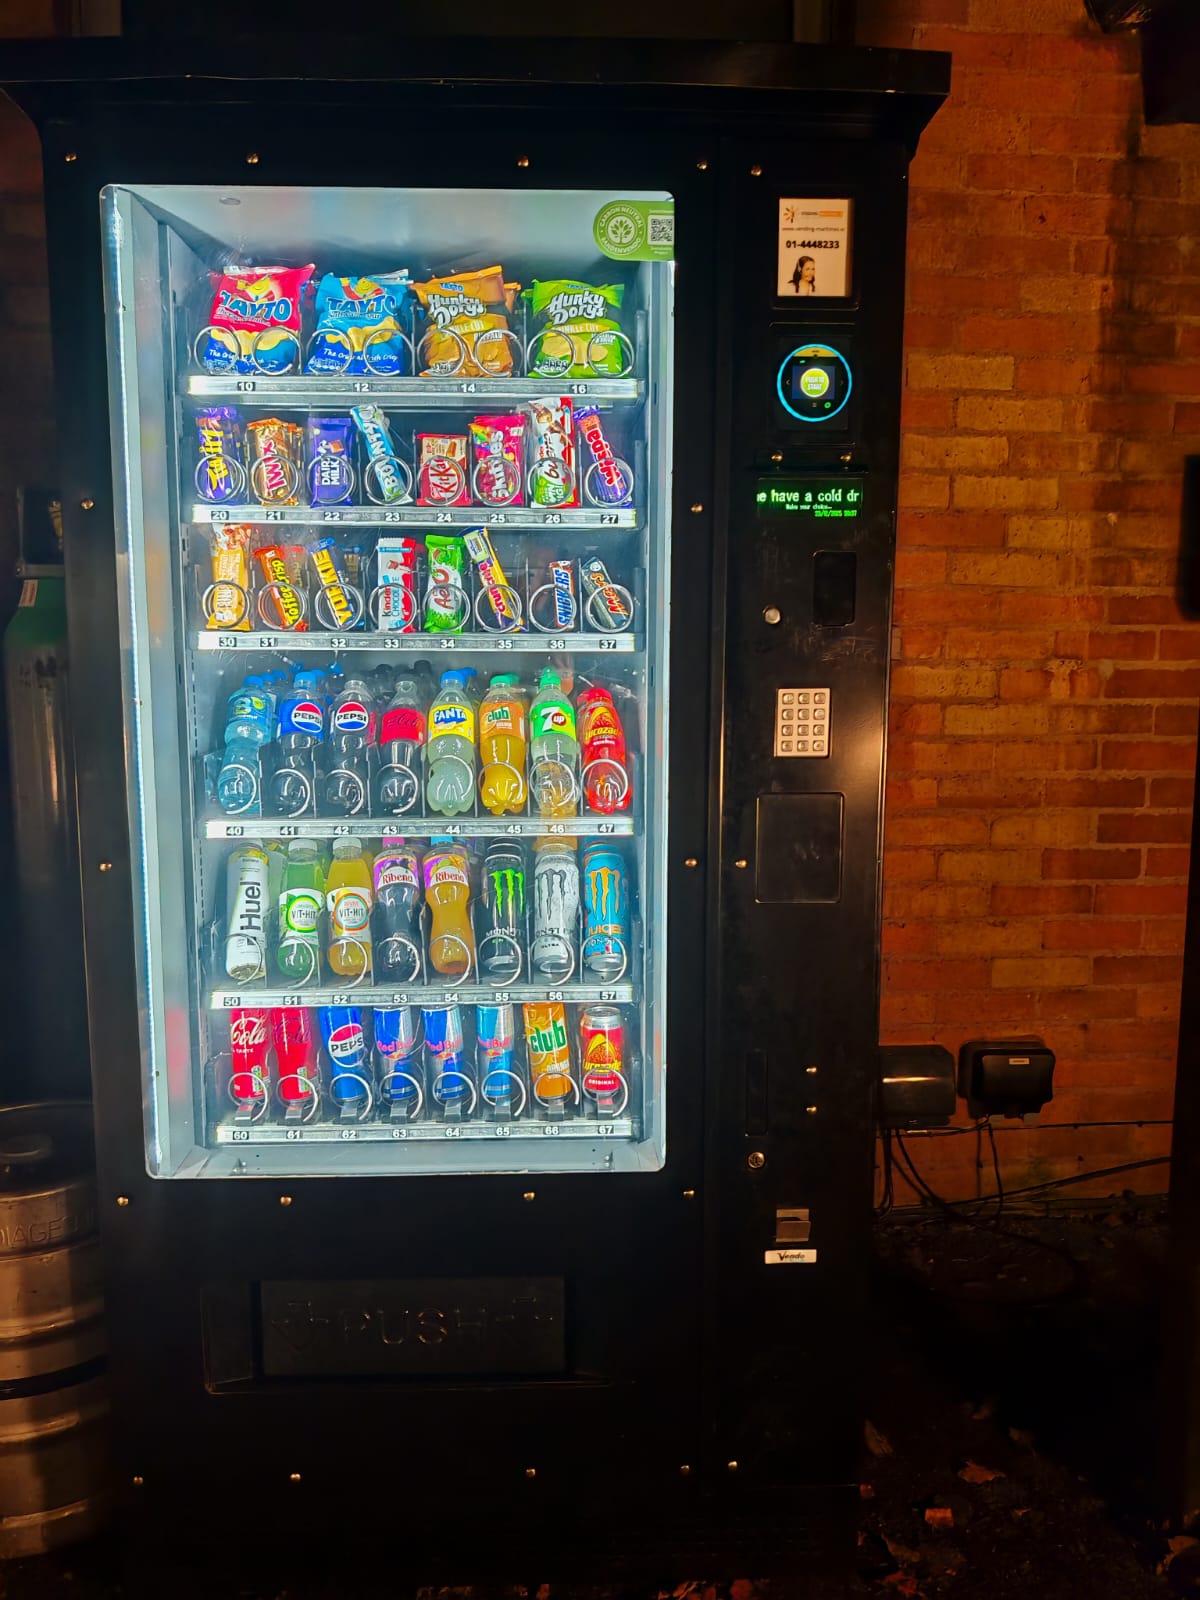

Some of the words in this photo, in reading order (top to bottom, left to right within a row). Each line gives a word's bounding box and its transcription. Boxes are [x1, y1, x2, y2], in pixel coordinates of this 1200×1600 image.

[785, 240, 840, 249] 01-4448233
[221, 290, 293, 322] TAYTO
[327, 294, 399, 316] TAYTO
[428, 293, 481, 312] Hunky
[546, 290, 605, 314] Hunky
[433, 304, 484, 329] Dorys
[552, 304, 605, 325] Dorys
[238, 383, 253, 391] 10
[354, 383, 369, 391] 12
[461, 384, 476, 393] 14
[572, 385, 586, 393] 16
[331, 459, 340, 486] MILK
[771, 489, 799, 502] have
[805, 492, 812, 502] a
[818, 489, 842, 502] cold
[847, 489, 860, 502] dr
[212, 512, 227, 520] 20
[268, 512, 281, 520] 21
[325, 512, 340, 521] 22
[385, 513, 400, 521] 23
[437, 514, 452, 522] 24
[490, 514, 505, 523] 25
[546, 514, 560, 523] 26
[603, 515, 617, 523] 27
[219, 639, 234, 647] 30
[261, 639, 274, 647] 31
[331, 639, 346, 648] 32
[385, 639, 399, 648] 33
[440, 640, 455, 648] 34
[498, 640, 512, 648] 35
[550, 640, 565, 649] 36
[601, 640, 615, 649] 37
[294, 712, 322, 725] PEPSI
[337, 713, 367, 722] PEPSI
[434, 707, 467, 722] FANTA
[488, 706, 510, 722] club
[227, 827, 242, 836] 40
[281, 827, 295, 835] 41
[335, 827, 349, 835] 42
[383, 827, 398, 835] 43
[446, 826, 460, 834] 44
[507, 826, 521, 834] 45
[550, 825, 564, 834] 46
[600, 825, 614, 833] 47
[383, 873, 412, 884] Ribena
[436, 871, 464, 882] Ribena
[240, 881, 261, 931] Huel
[334, 996, 349, 1005] 52
[394, 995, 408, 1004] 53
[445, 993, 458, 1001] 54
[495, 993, 510, 1001] 55
[549, 992, 564, 1001] 56
[602, 992, 615, 1000] 57
[224, 998, 239, 1006] 50
[285, 997, 298, 1005] 51
[530, 1020, 566, 1052] club
[331, 1037, 363, 1053] PEPS
[287, 1131, 300, 1139] 61
[342, 1131, 357, 1139] 62
[393, 1130, 407, 1138] 63
[446, 1129, 460, 1137] 64
[496, 1128, 510, 1137] 65
[546, 1128, 560, 1136] 66
[599, 1127, 613, 1135] 67
[233, 1132, 248, 1140] 60
[777, 1251, 805, 1261] Vendo
